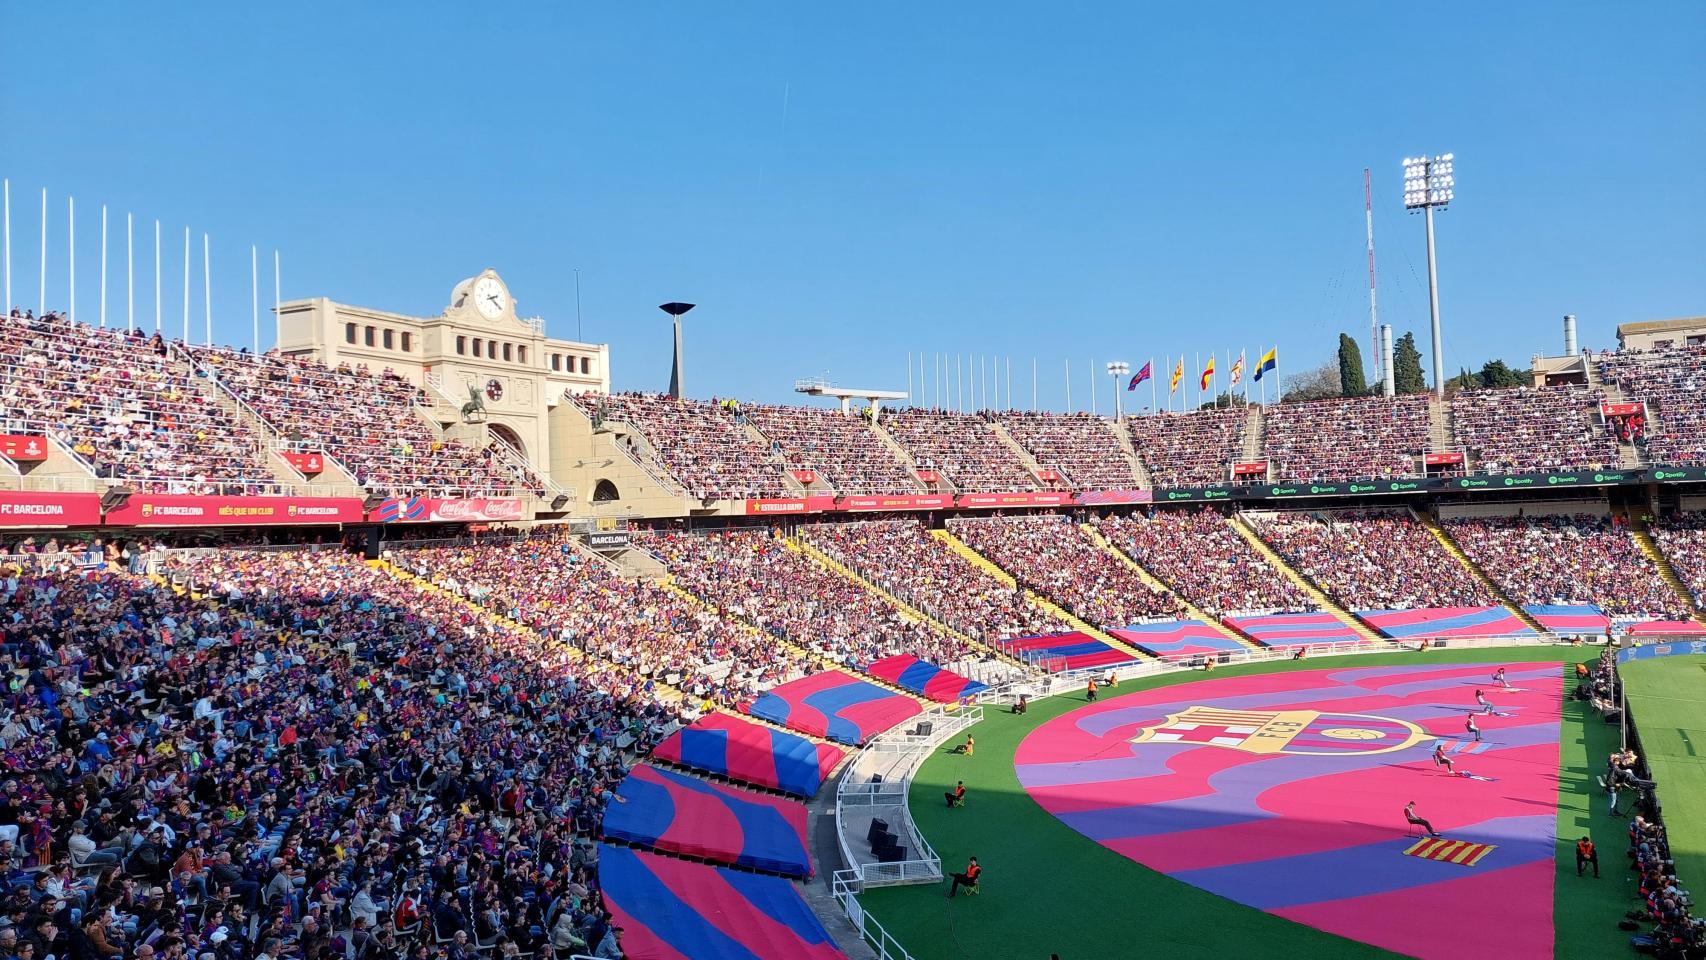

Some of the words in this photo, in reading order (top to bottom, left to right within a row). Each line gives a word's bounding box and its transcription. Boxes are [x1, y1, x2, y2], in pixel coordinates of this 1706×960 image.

[1, 504, 12, 514] FC
[13, 504, 64, 514] BARCELONA
[153, 506, 164, 515] FC
[164, 506, 204, 516] BARCELONA
[592, 536, 628, 544] BARCELONA
[1256, 722, 1302, 738] FCB
